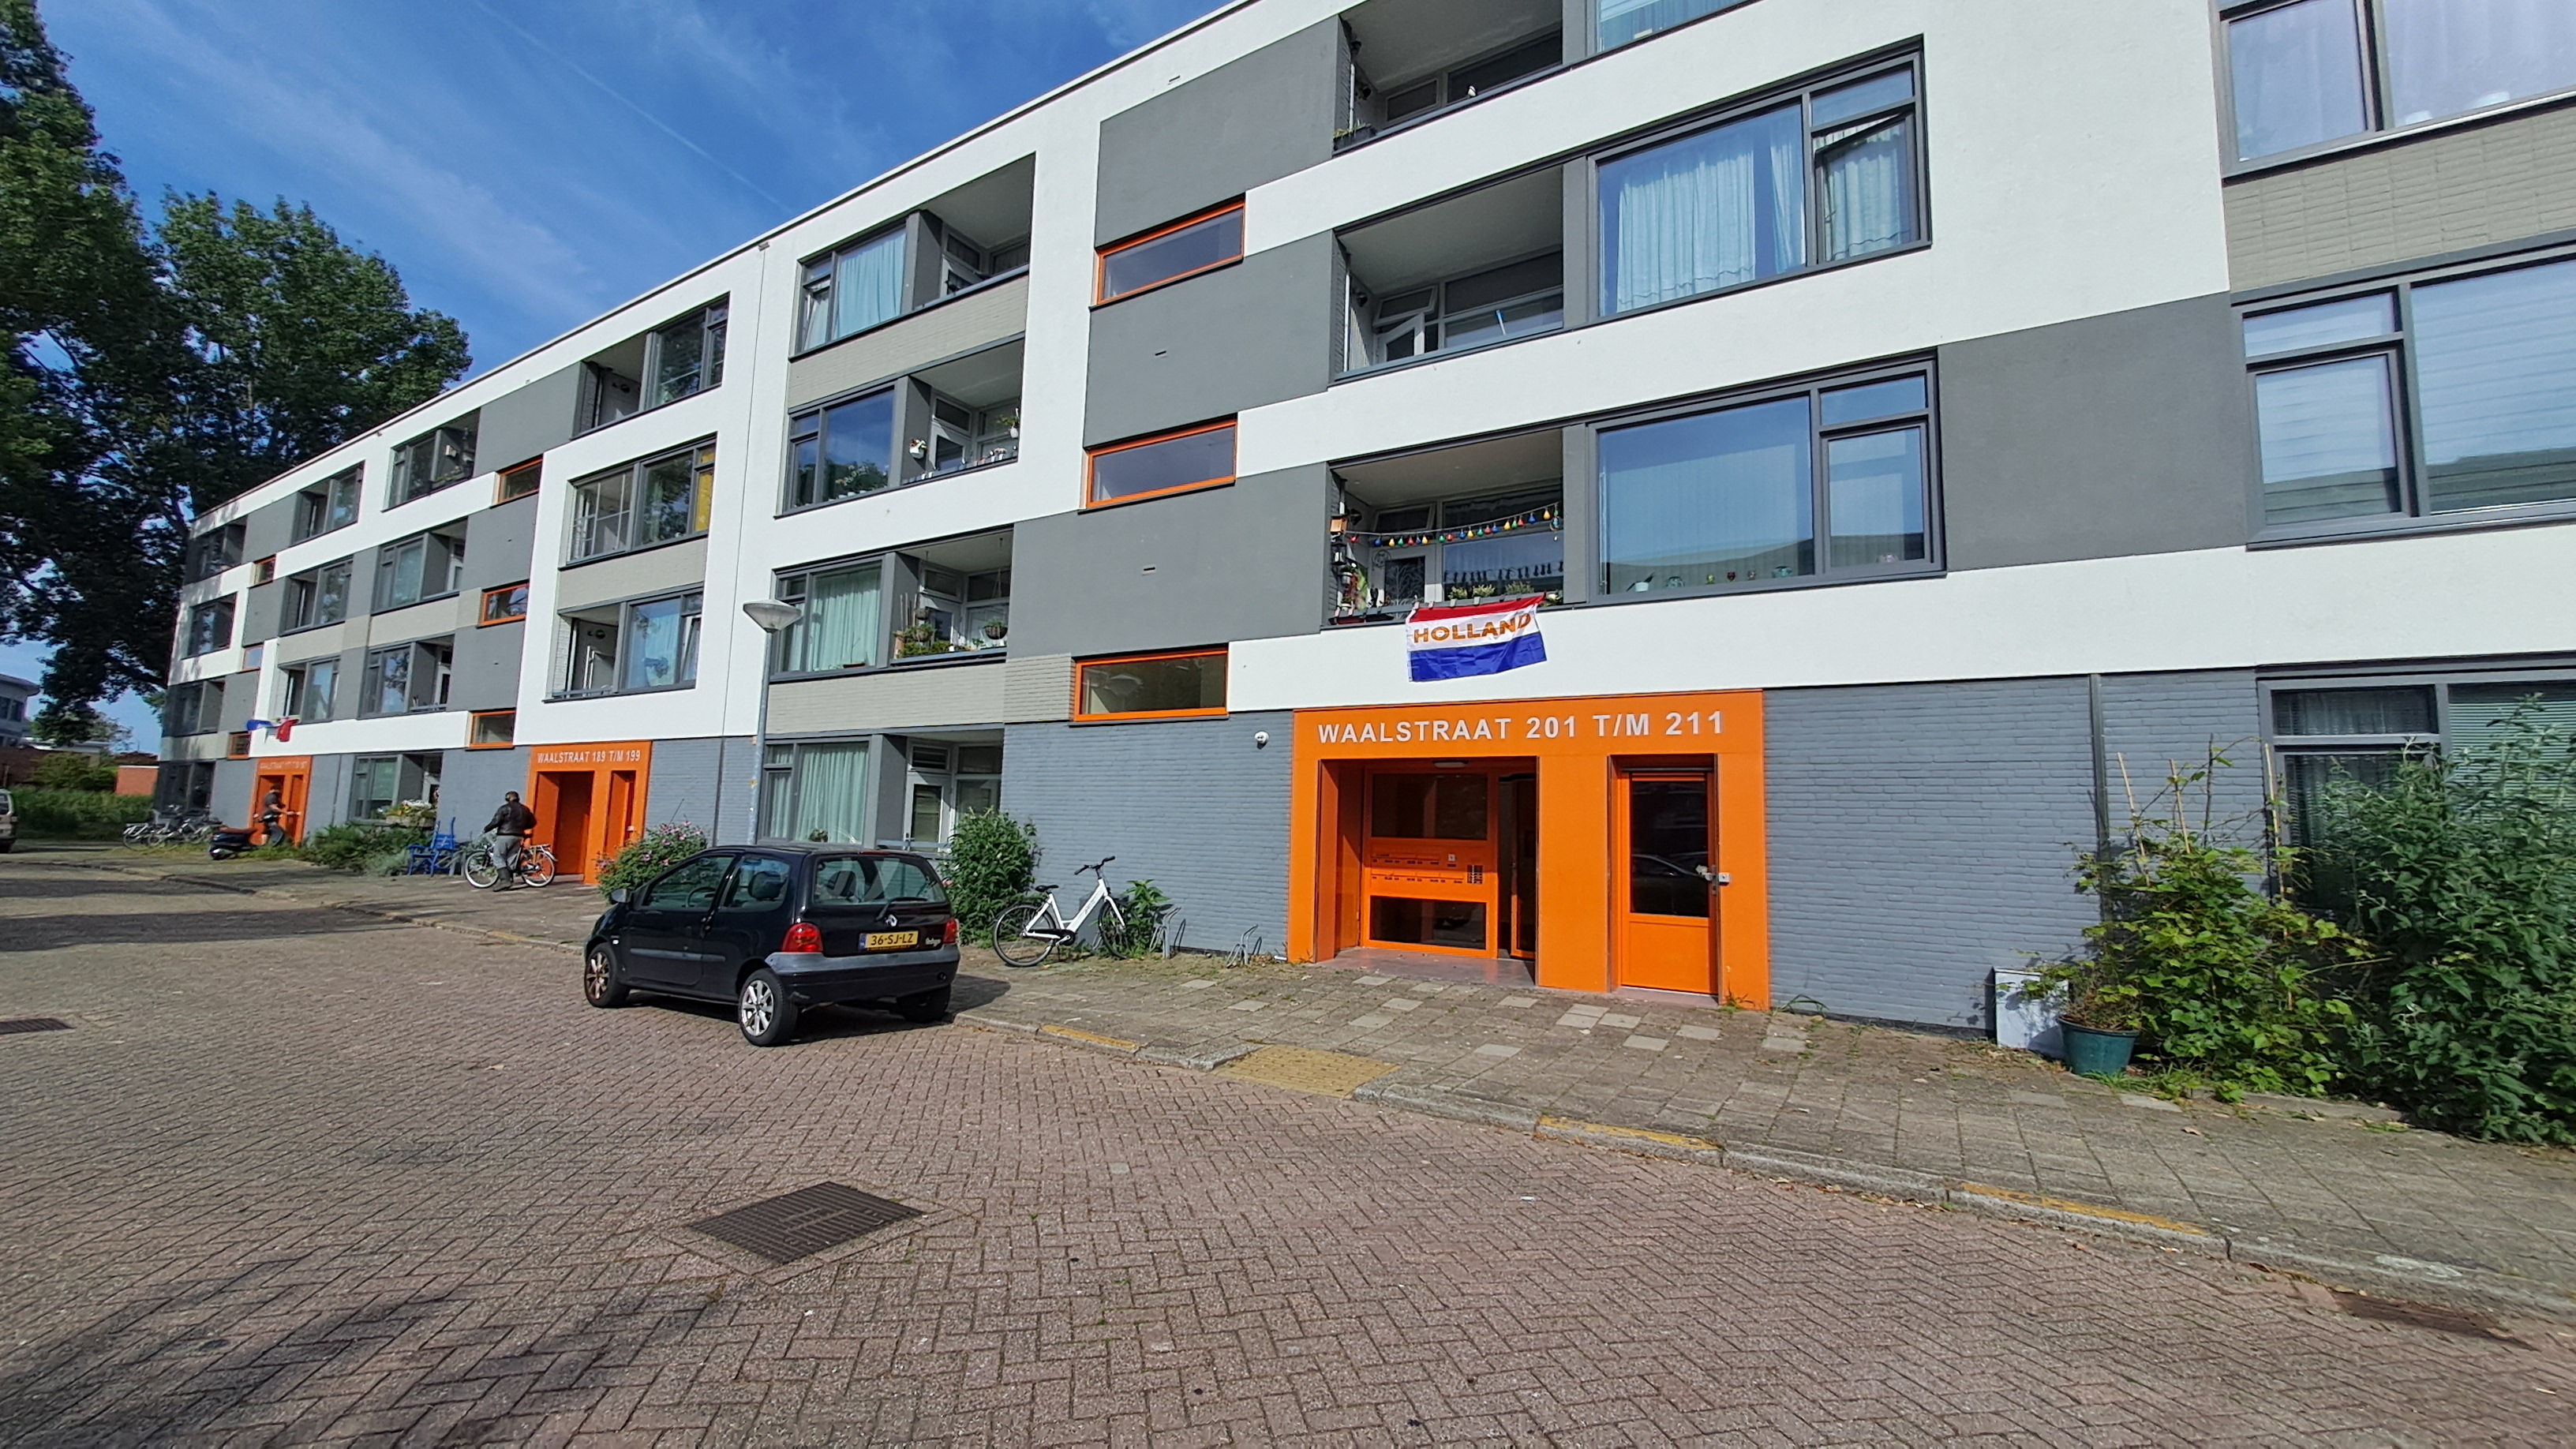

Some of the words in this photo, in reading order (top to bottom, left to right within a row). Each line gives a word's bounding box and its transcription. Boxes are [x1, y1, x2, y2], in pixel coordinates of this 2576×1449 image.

[1413, 612, 1531, 643] HOLLAND
[1317, 717, 1512, 743] WAALSTRAAT
[1526, 715, 1576, 739] 201
[1592, 713, 1650, 737] T/M
[1665, 710, 1724, 736] 211
[537, 751, 590, 763] WAALSTRAAT
[592, 751, 605, 762] 189
[609, 750, 623, 762] T/M
[627, 750, 641, 762] 199
[871, 933, 914, 945] 36-SJ-LZ
